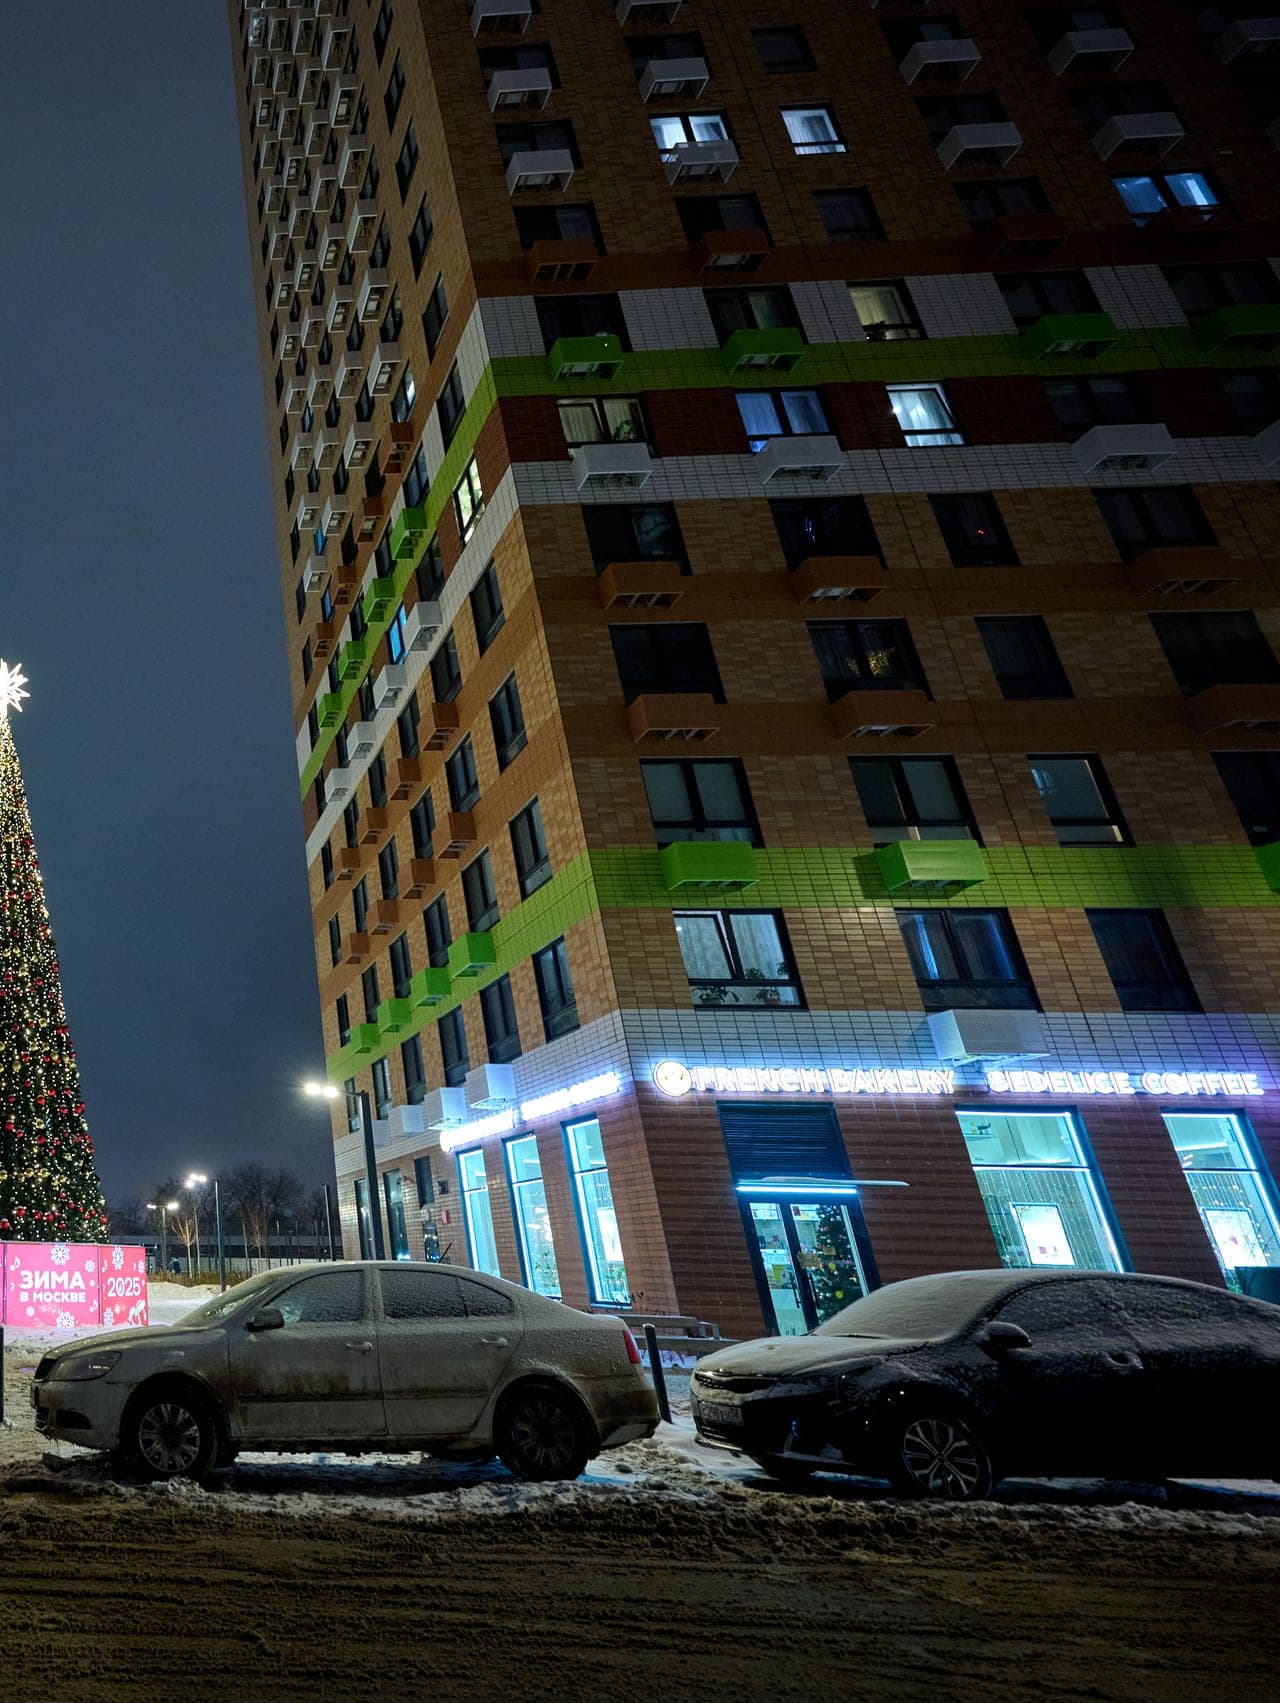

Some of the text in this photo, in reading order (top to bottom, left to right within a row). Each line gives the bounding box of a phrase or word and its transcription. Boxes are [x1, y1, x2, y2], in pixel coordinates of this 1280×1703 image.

[694, 1066, 955, 1094] FRENCH BAKERY
[1142, 1072, 1265, 1095] COFFEE
[20, 1270, 86, 1290] ЗИМА
[107, 1277, 142, 1297] 2025
[20, 1291, 86, 1303] В МОСКВЕ
